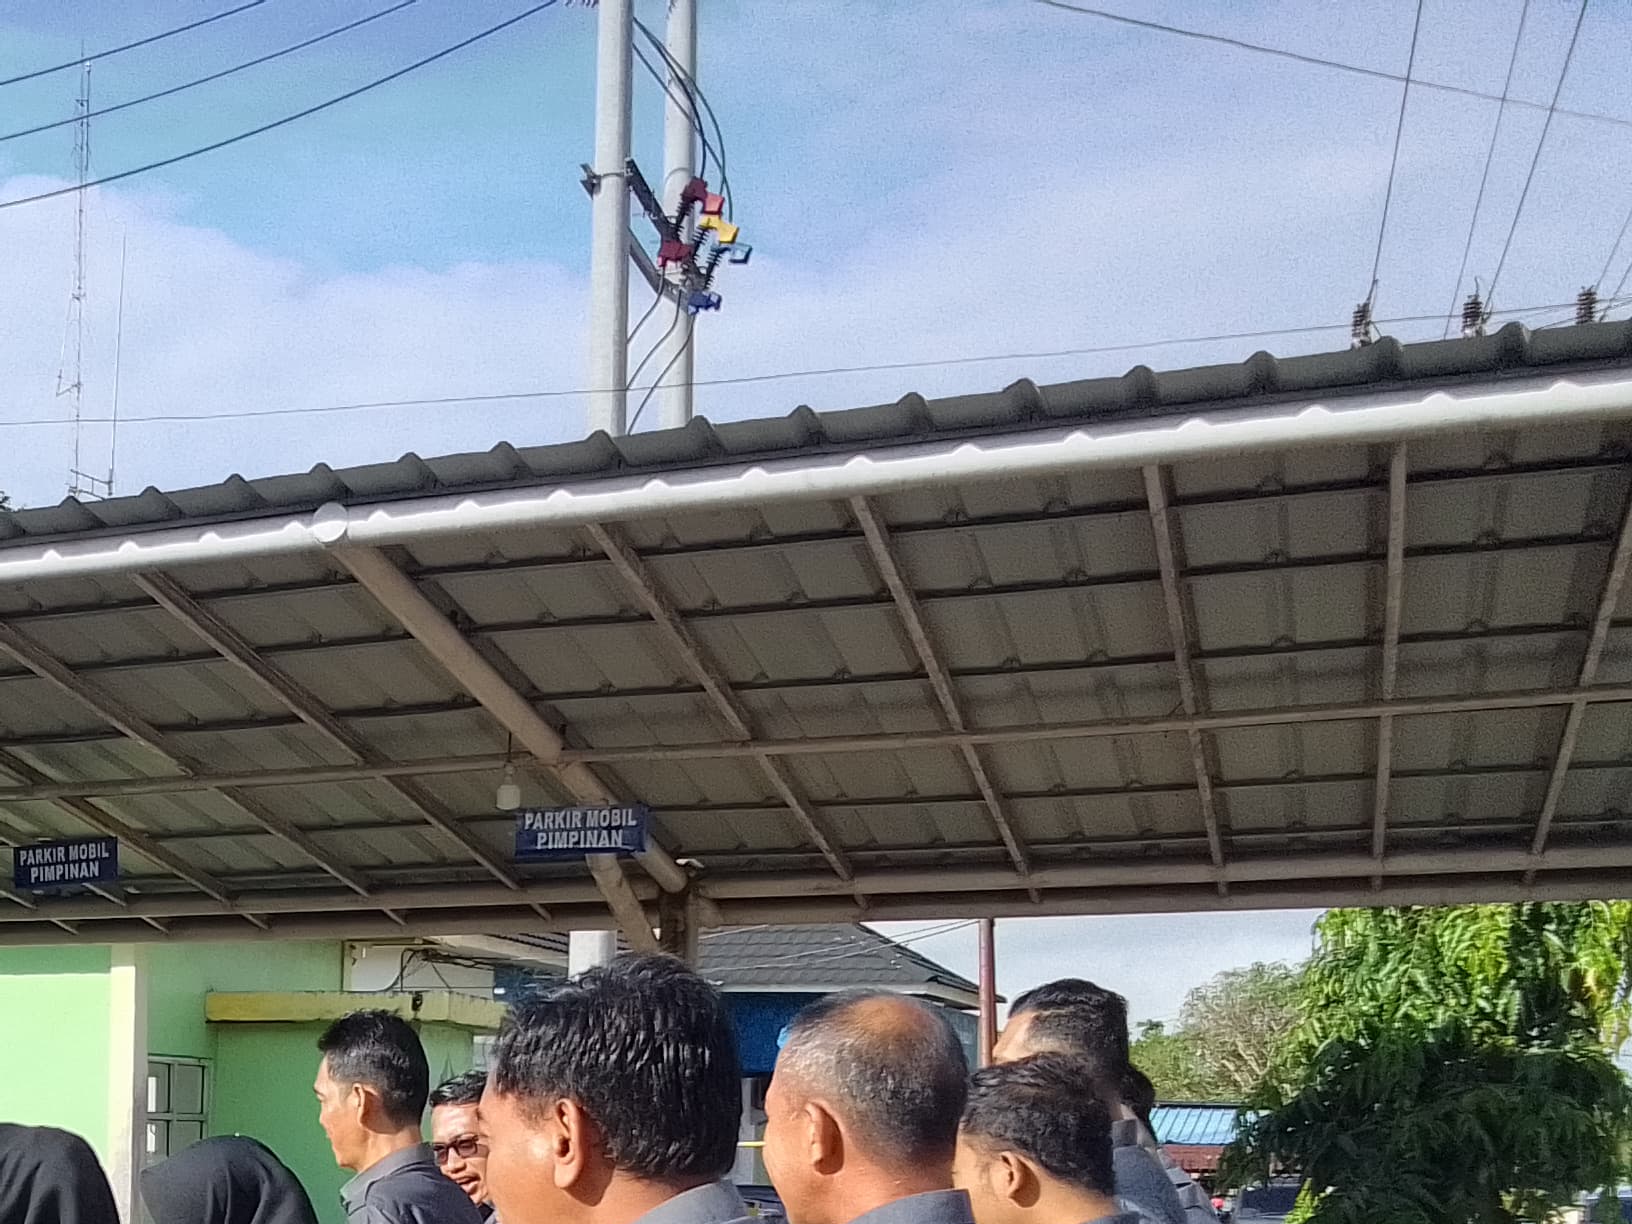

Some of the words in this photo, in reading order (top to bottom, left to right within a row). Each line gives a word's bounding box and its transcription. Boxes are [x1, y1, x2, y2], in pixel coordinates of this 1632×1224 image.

[524, 810, 582, 829] PARKIR
[586, 808, 637, 827] MOBIL
[536, 829, 623, 850] PIMPINAN
[19, 846, 66, 866] PARKIR
[68, 842, 109, 861] MOBIL
[30, 861, 99, 883] PIMPINAN
